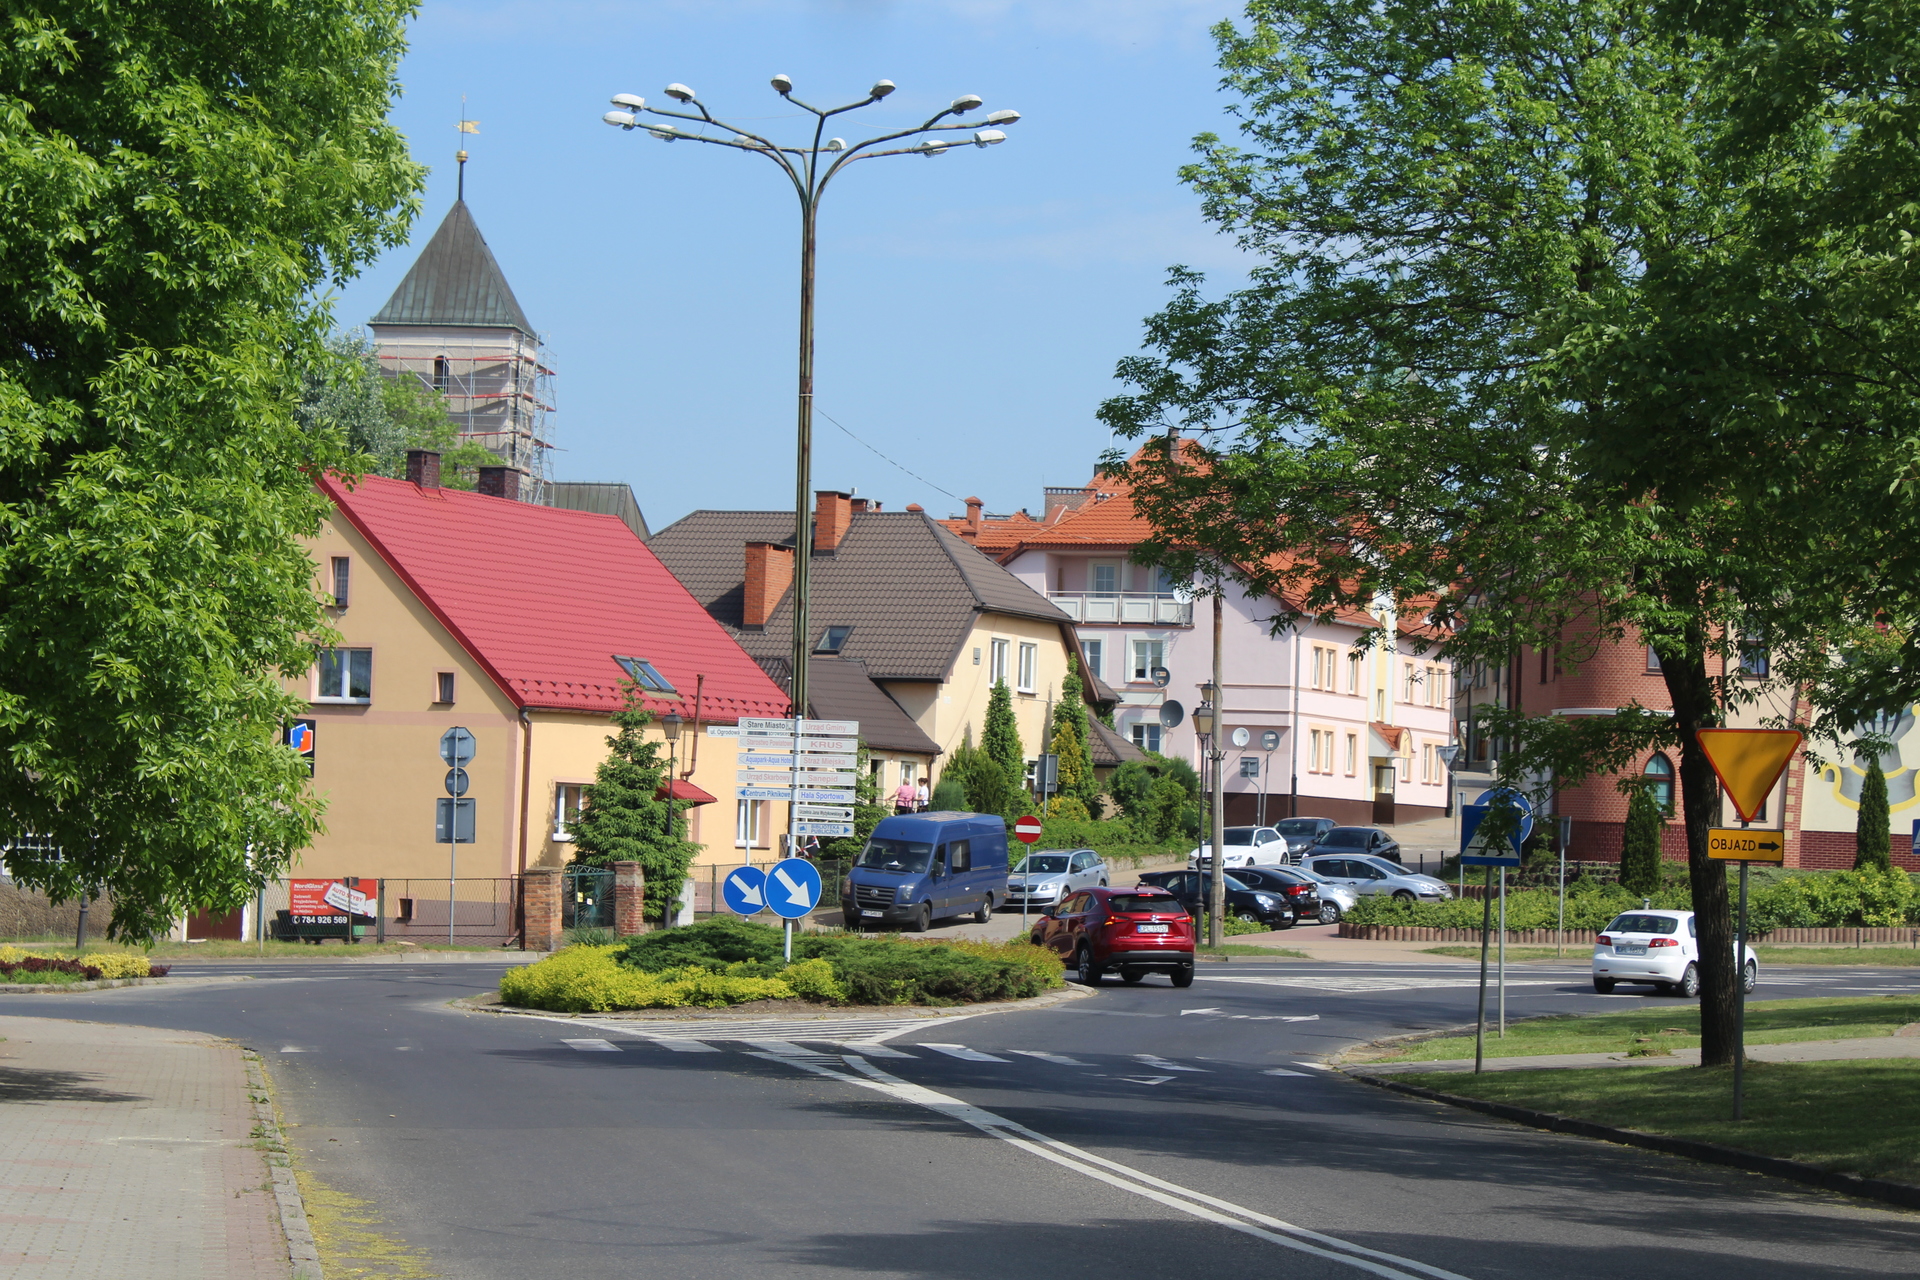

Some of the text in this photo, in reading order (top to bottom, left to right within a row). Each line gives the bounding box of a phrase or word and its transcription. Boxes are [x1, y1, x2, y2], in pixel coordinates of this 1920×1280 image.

[765, 721, 786, 729] Miasto
[805, 723, 847, 733] Urząd Gminy
[821, 758, 846, 767] Miejska
[746, 773, 791, 782] Urząd Skarbowy
[808, 775, 838, 783] Sanepid
[815, 792, 844, 801] Sportowa
[1711, 838, 1756, 851] OBJAZD
[332, 886, 346, 897] AUTO
[301, 916, 347, 924] 784 926 569
